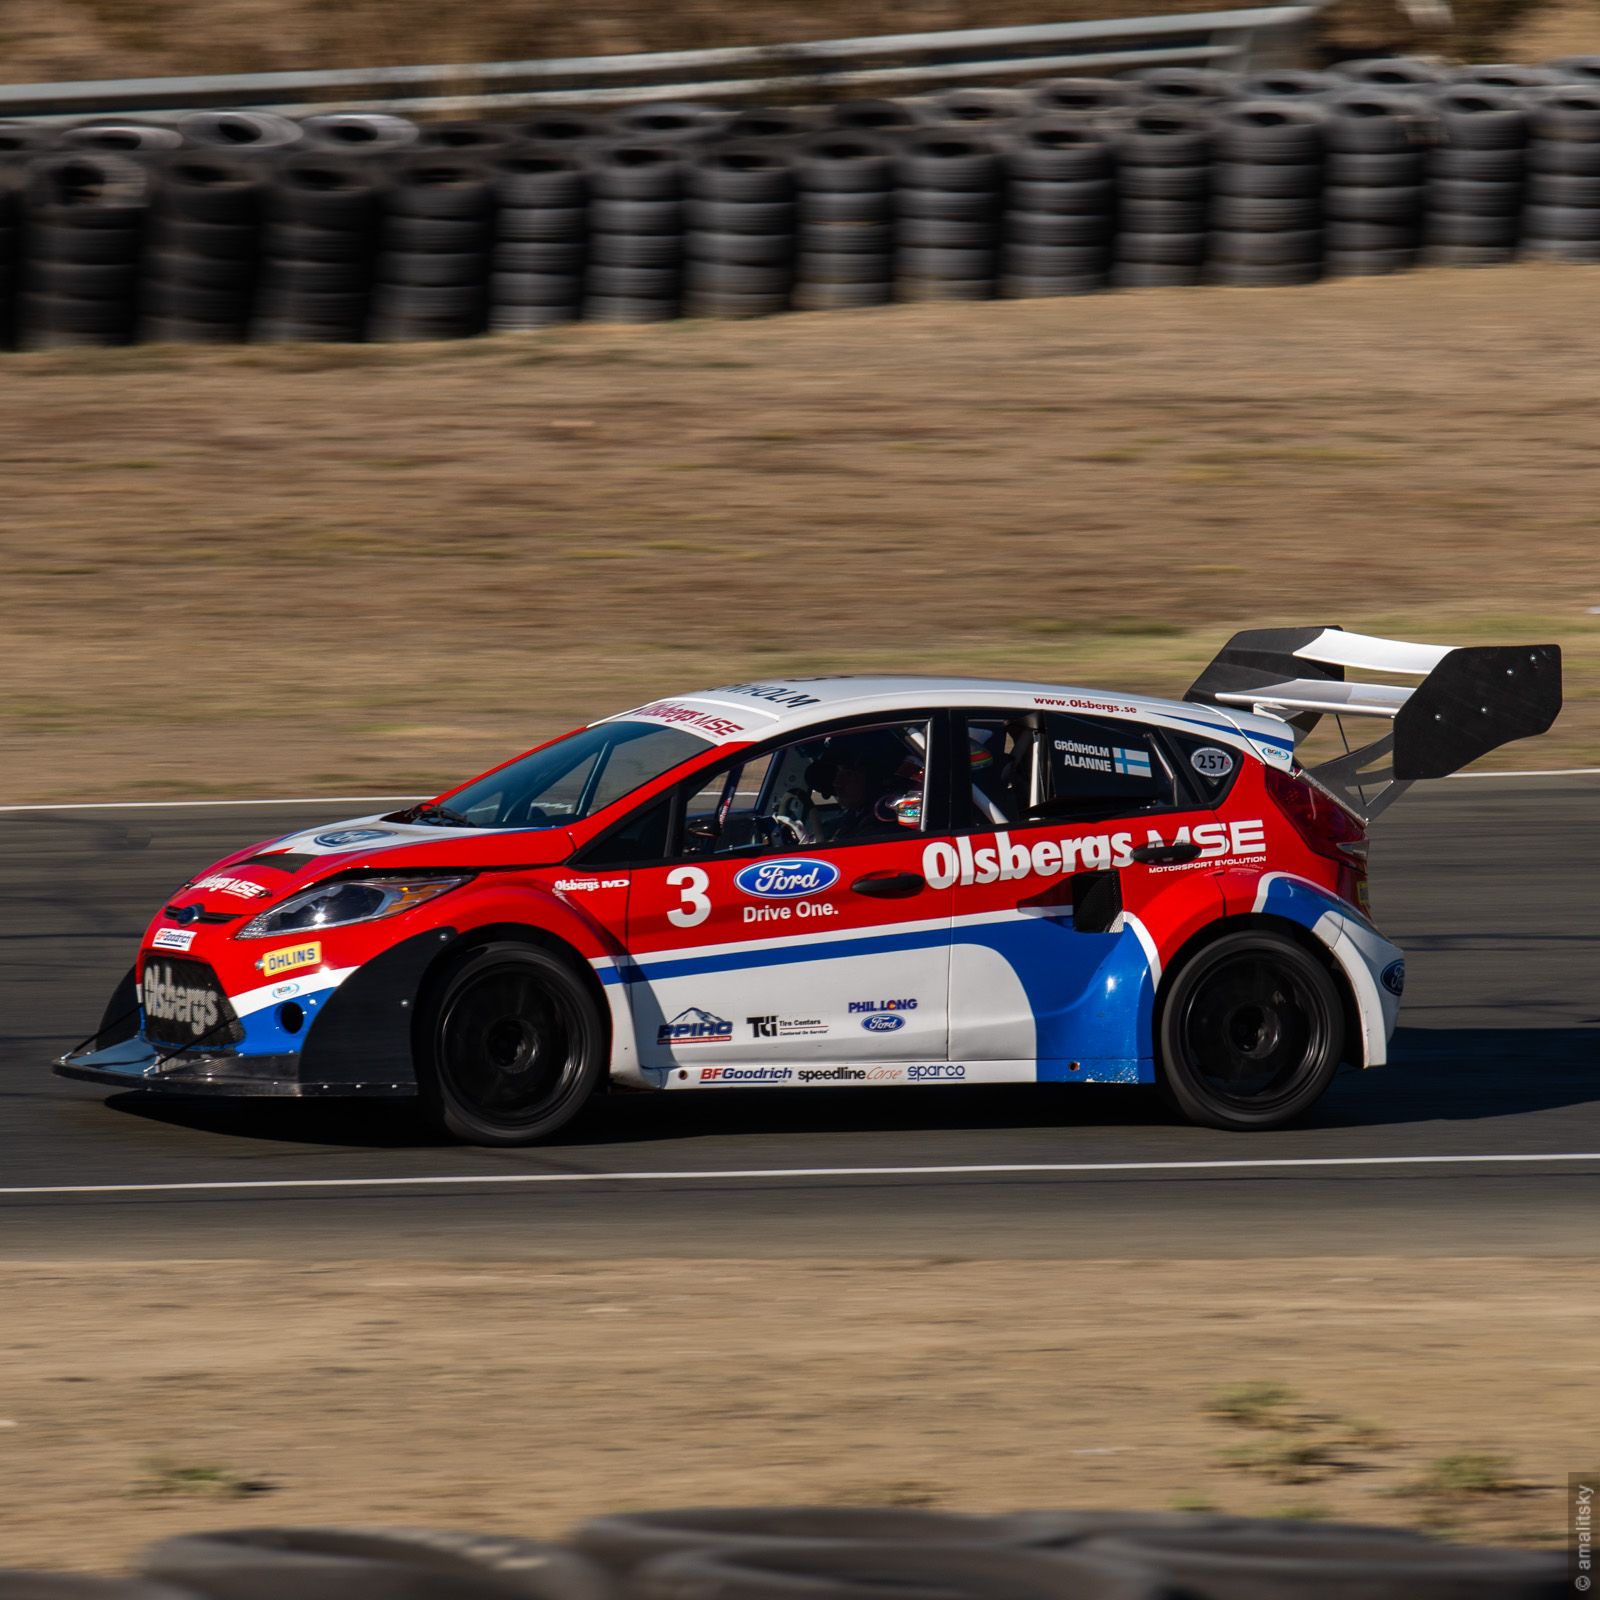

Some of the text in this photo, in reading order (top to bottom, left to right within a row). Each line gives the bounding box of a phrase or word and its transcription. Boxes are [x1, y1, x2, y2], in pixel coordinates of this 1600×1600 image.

[1034, 697, 1137, 713] www.Olsbergs.se
[689, 715, 744, 736] MSE
[1054, 739, 1110, 757] GRÖNHOLM
[1064, 754, 1112, 772] ALANNE
[1198, 754, 1225, 769] 257
[1148, 855, 1267, 874] MOTORSPORT EVOLUTION
[555, 879, 600, 891] Olsbergs
[757, 863, 820, 892] Ford
[224, 879, 266, 897] MSE
[666, 866, 711, 928] 3
[743, 901, 839, 923] Drive One.
[848, 999, 918, 1013] PHIL LONG
[658, 1021, 733, 1039] PPIHC
[869, 1015, 898, 1030] Ford
[700, 1067, 793, 1080] BFGoodrich
[798, 1066, 902, 1083] speedline Corse
[907, 1065, 965, 1082] sparco
